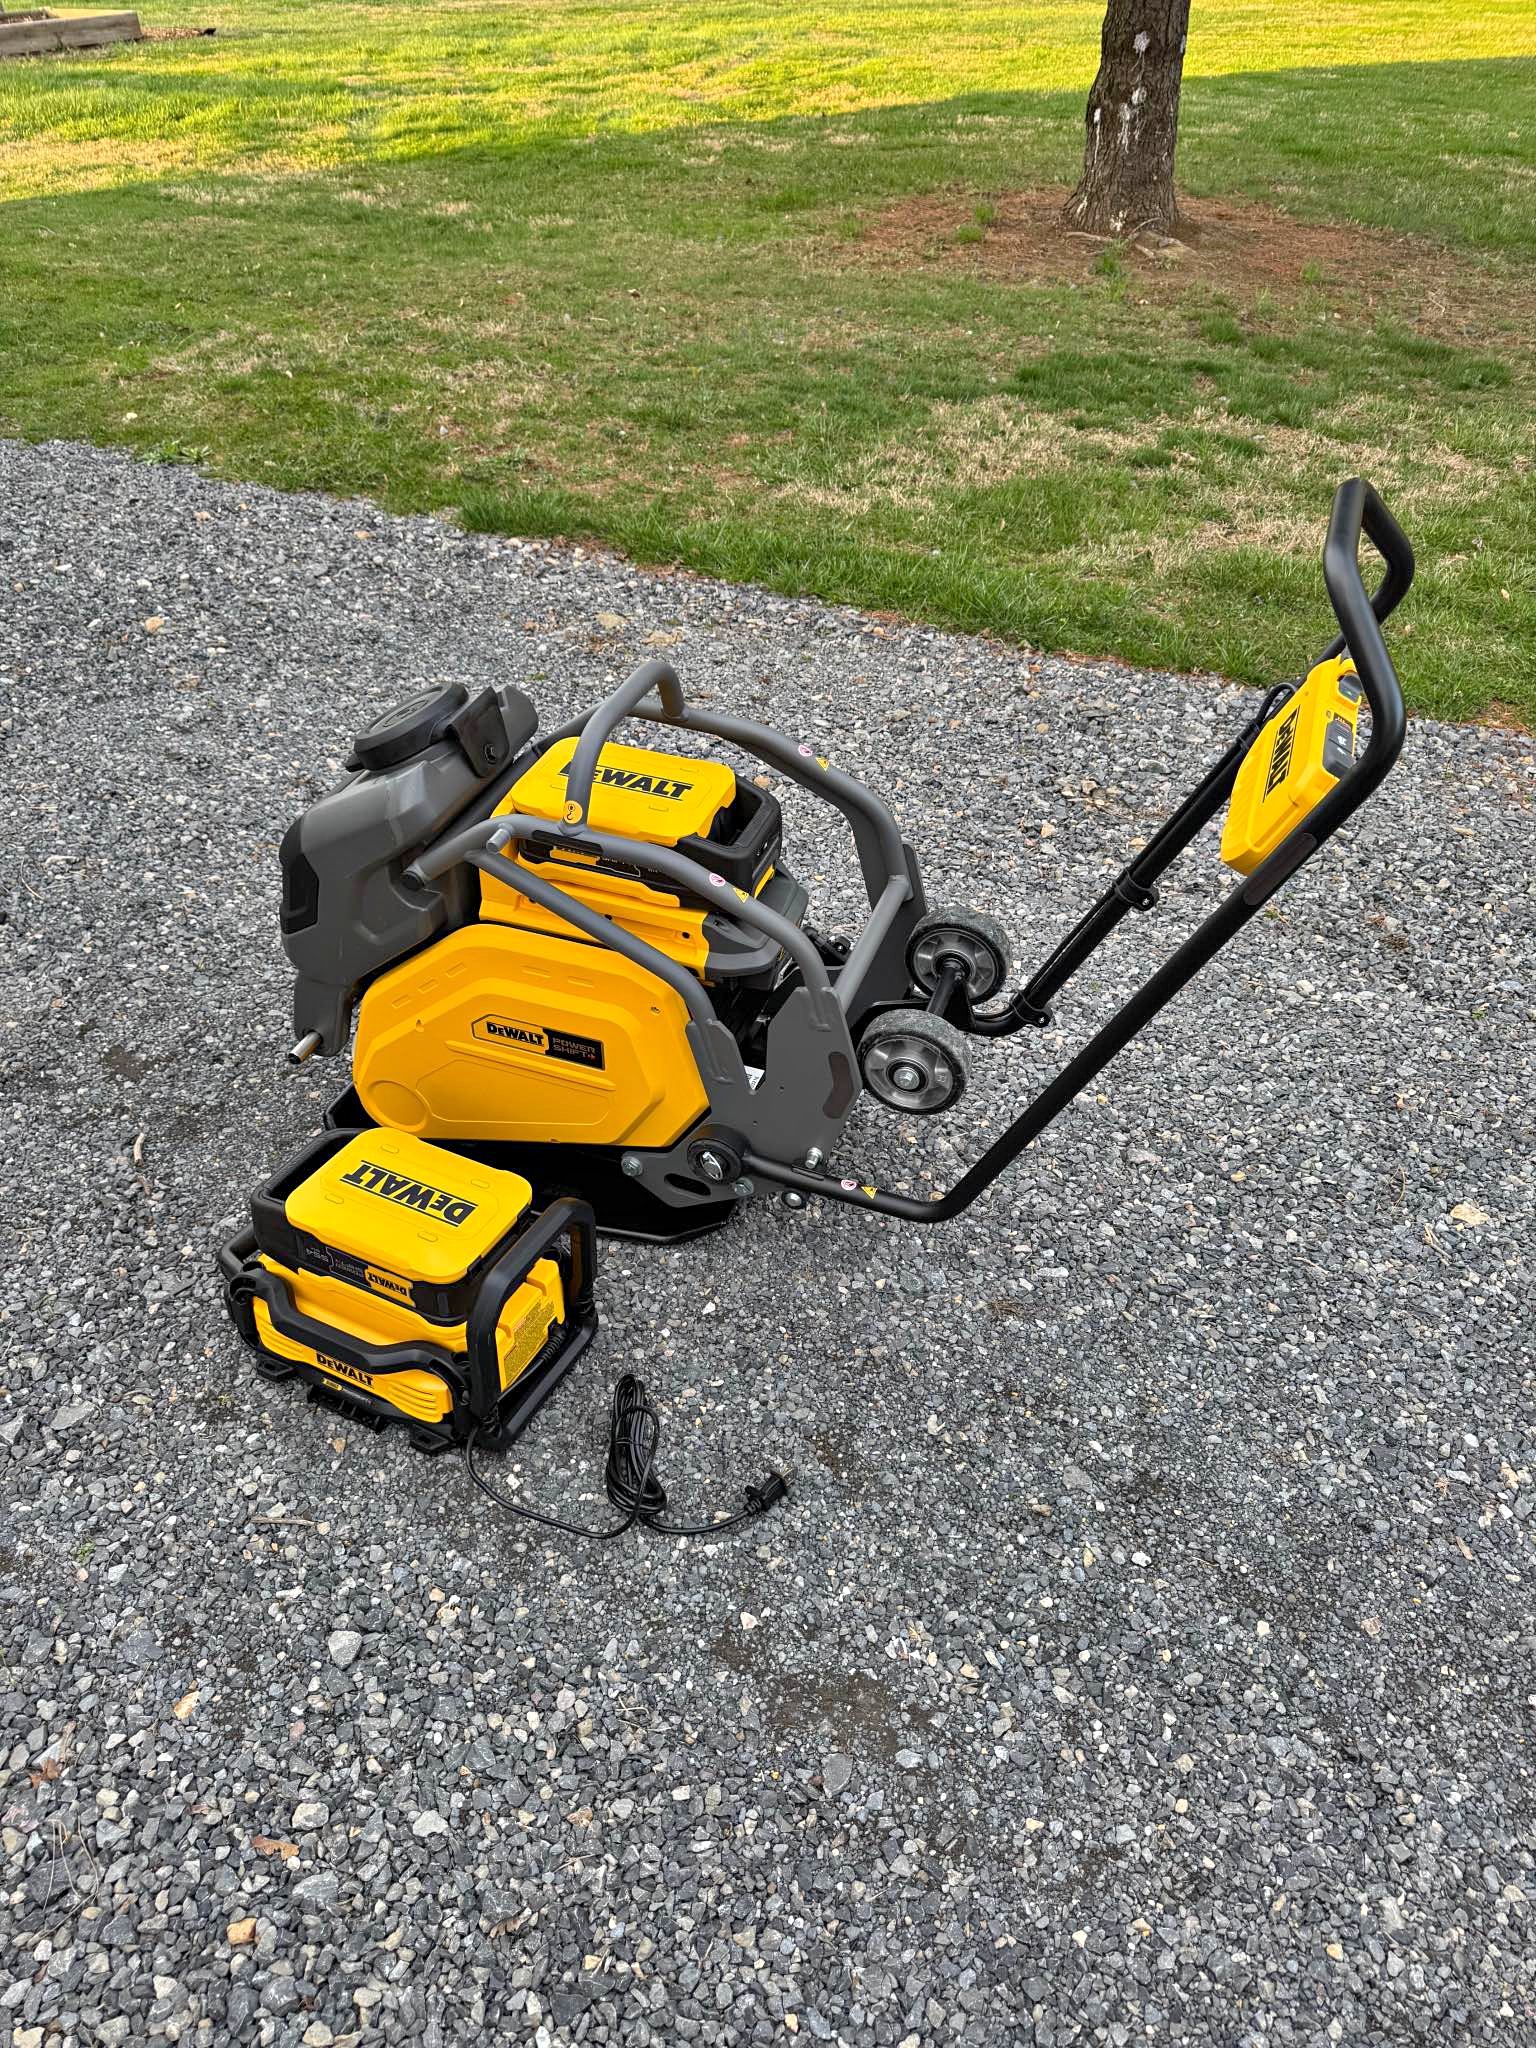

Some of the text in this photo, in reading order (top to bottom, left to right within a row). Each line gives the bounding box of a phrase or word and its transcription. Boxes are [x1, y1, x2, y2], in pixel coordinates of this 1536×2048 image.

[1265, 707, 1298, 797] DEWALT
[560, 761, 692, 798] WALT
[486, 1022, 544, 1045] DEWALT
[342, 1164, 476, 1225] DEWALT
[367, 1272, 408, 1296] DEWALT
[316, 1353, 374, 1386] DEWALT
